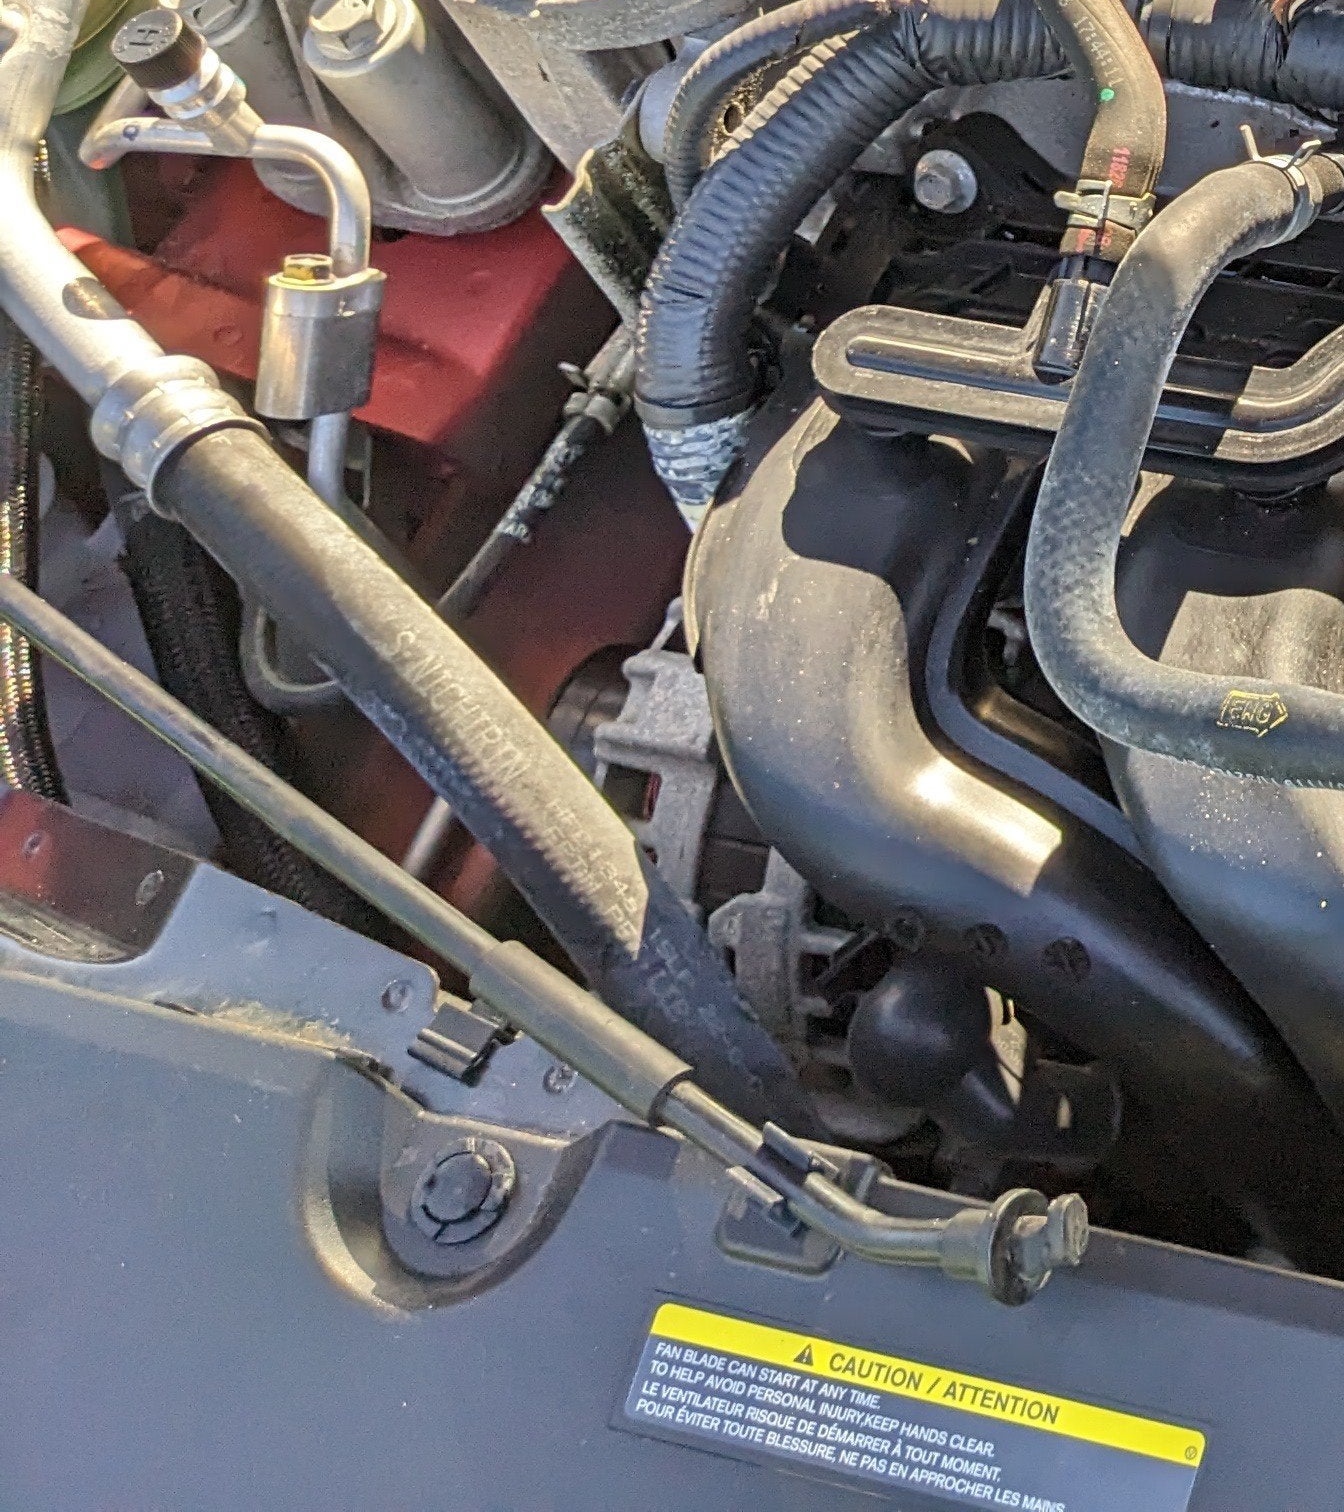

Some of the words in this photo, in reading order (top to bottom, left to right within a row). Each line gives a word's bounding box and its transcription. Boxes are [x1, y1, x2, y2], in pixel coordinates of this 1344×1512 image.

[650, 1360, 667, 1375] TO
[670, 1364, 704, 1384] HELP
[705, 1374, 746, 1395] AVOID
[748, 1383, 817, 1414] PERSONAL
[901, 1422, 947, 1446] HANDS
[949, 1433, 995, 1456] CLEAR.
[655, 1341, 681, 1360] FAN
[682, 1348, 727, 1372] BLADE
[728, 1360, 757, 1378] CAN
[758, 1367, 801, 1390] START
[801, 1378, 818, 1393] AT
[818, 1382, 847, 1401] ANY
[849, 1389, 882, 1409] TIME.
[829, 1352, 923, 1392] CAUTION
[943, 1380, 1061, 1425] ATTENTION
[636, 1399, 674, 1420] POUR
[675, 1405, 721, 1431] ÉVITER
[722, 1421, 765, 1443] TOUTE
[765, 1430, 836, 1463] BLESSURE,
[840, 1450, 858, 1466] NE
[861, 1455, 887, 1474] PAS
[889, 1463, 908, 1478] EN
[910, 1468, 993, 1499] APPROCHER
[994, 1489, 1020, 1507] LES
[1021, 1495, 1065, 1512] MAINS
[642, 1380, 659, 1395] LE
[660, 1383, 744, 1416] VENTILATEUR
[745, 1405, 794, 1431] RISQUE
[797, 1418, 816, 1435] DE
[817, 1420, 896, 1455] DÉMARRER
[890, 1438, 903, 1457] À
[905, 1443, 940, 1465] TOUT
[941, 1451, 1001, 1482] MOMENT.
